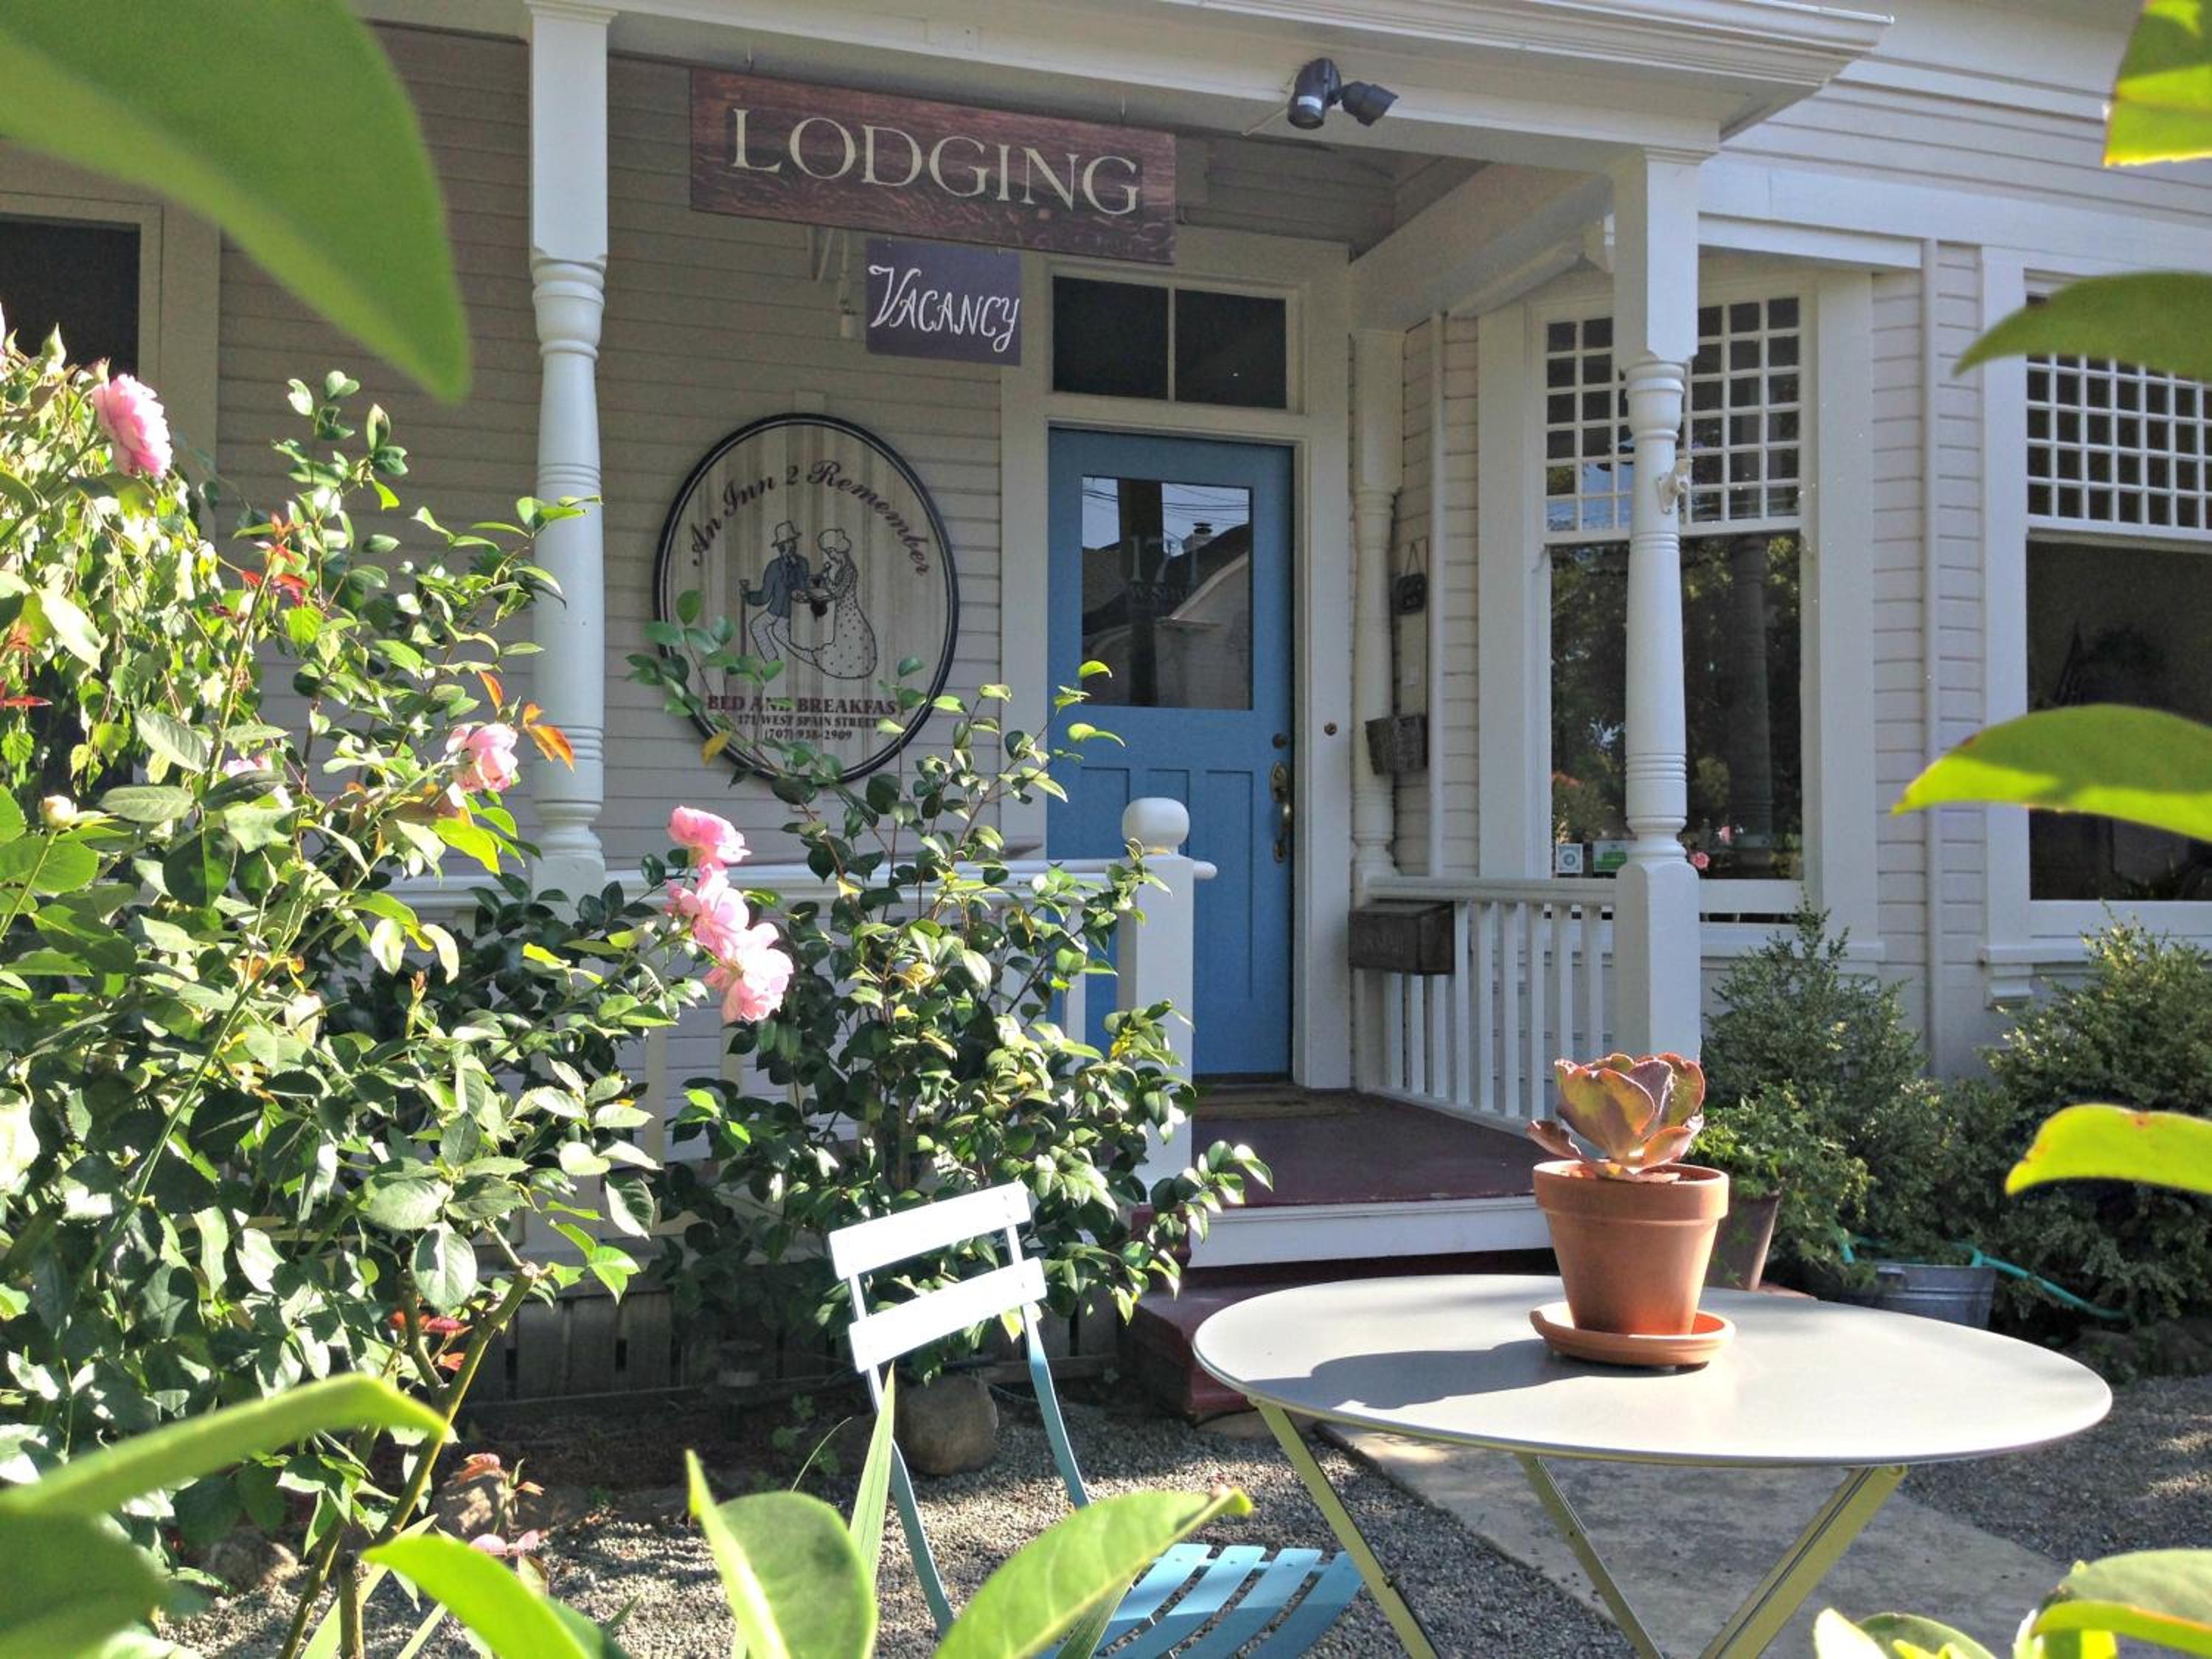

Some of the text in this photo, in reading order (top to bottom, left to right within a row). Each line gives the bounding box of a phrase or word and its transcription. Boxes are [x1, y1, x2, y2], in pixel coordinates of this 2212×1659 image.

[731, 108, 1140, 215] LODGING
[868, 264, 1020, 352] VACANCY
[692, 459, 931, 576] An Inn 2 Remember
[708, 695, 745, 710] BED
[797, 697, 899, 714] BREAKFAS
[760, 714, 793, 726] WEST
[796, 715, 832, 727] SPAIN
[834, 717, 878, 728] STREET
